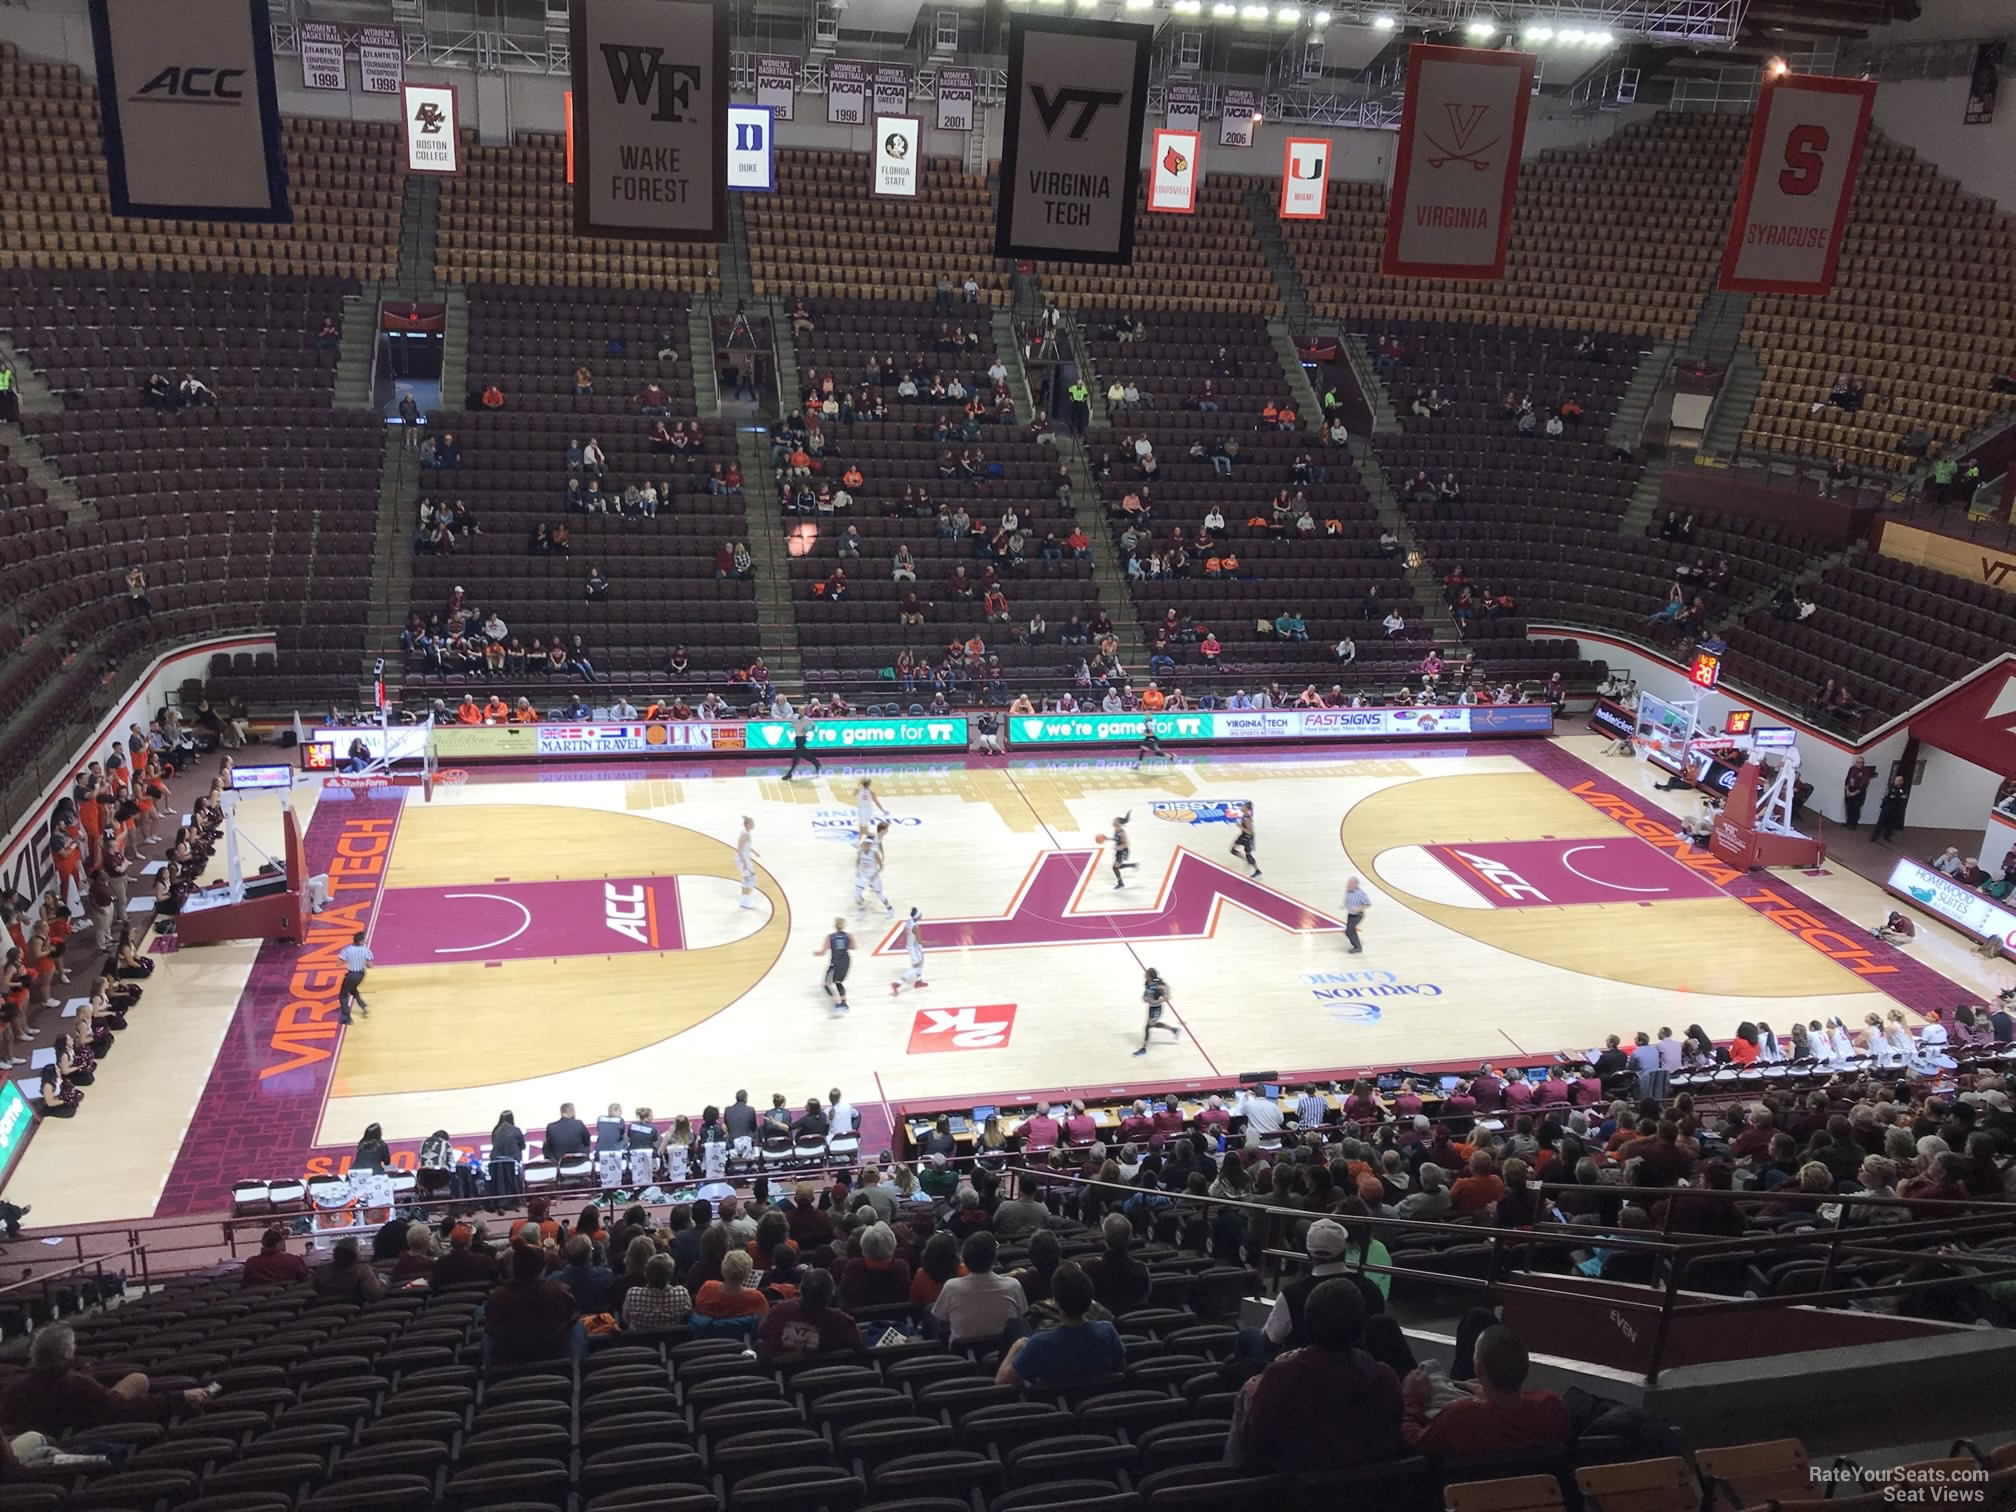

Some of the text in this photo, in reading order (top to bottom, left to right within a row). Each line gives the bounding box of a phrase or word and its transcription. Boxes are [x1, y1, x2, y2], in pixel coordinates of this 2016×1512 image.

[304, 23, 337, 34] WOMEN'S
[363, 28, 395, 39] WOMEN'S
[302, 31, 341, 41] BASKETBALL
[361, 35, 399, 47] BASKETBALL
[304, 45, 341, 57] ATLANTIC 10
[362, 49, 400, 61] ATLANTIC 10
[761, 59, 790, 68] WOMEN'S
[834, 63, 861, 73] WOMEN'S
[758, 66, 793, 76] BASKETBALL
[830, 70, 864, 80] BASKETBALL
[878, 68, 904, 77] WOMEN'S
[943, 71, 970, 80] WOMEN'S
[136, 66, 246, 98] ACC
[312, 73, 339, 87] 1998
[371, 77, 396, 92] 1998
[600, 43, 700, 123] WF
[760, 79, 792, 90] NCAA
[875, 75, 906, 84] BASKETBALL
[940, 79, 972, 87] BASKETBALL
[831, 82, 862, 95] NCAA
[876, 86, 904, 97] NCAA
[1172, 86, 1198, 95] WOMEN'S
[941, 90, 971, 101] NCAA
[1169, 92, 1200, 101] BASKETBALL
[774, 106, 787, 118] 95
[835, 109, 857, 121] 1998
[1026, 82, 1128, 142] VT
[1169, 104, 1198, 115] NCAA
[1224, 107, 1253, 118] NCAA
[944, 116, 965, 128] 2001
[1444, 103, 1490, 151] V
[1226, 132, 1246, 144] 2006
[416, 140, 447, 150] BOSTON
[416, 151, 448, 161] COLLEGE
[620, 145, 680, 173] WAKE
[1779, 124, 1830, 196] S
[738, 163, 758, 173] DUKE
[881, 166, 910, 176] FLORIDA
[885, 176, 905, 186] STATE
[1030, 170, 1110, 198] VIRGINIA
[612, 176, 689, 203] FOREST
[1155, 185, 1190, 195] LOUISVILLE
[1294, 192, 1314, 201] MIAMI
[1044, 201, 1091, 226] TECH
[1417, 205, 1488, 229] VIRGINIA
[1747, 224, 1828, 248] SYRACUSE
[1982, 556, 2016, 586] VT
[1696, 663, 1712, 685] 28
[1226, 719, 1288, 729] VIRGINIA TECH
[1305, 713, 1381, 726] FASTSIGNS
[1046, 718, 1200, 739] we're game for VT
[1732, 721, 1745, 731] 28
[842, 728, 896, 745] game
[901, 723, 925, 740] for
[927, 723, 954, 741] VT
[542, 739, 592, 752] MARTIN
[595, 738, 643, 751] TRAVEL
[310, 755, 326, 768] 28
[1569, 780, 1743, 886] VIRGINIA
[327, 818, 394, 898] TECH
[1454, 849, 1552, 903] ACC
[1915, 868, 1975, 905] HOMEWOOD
[1937, 891, 1970, 915] SUITES
[605, 882, 648, 944] ACC
[1742, 888, 1901, 975] TECH
[1299, 970, 1397, 985] CLINIC
[259, 900, 372, 1080] VIRGINIA
[1312, 983, 1442, 1000] CARILION
[919, 1007, 1009, 1048] 2K
[1610, 1309, 1637, 1343] EVEN
